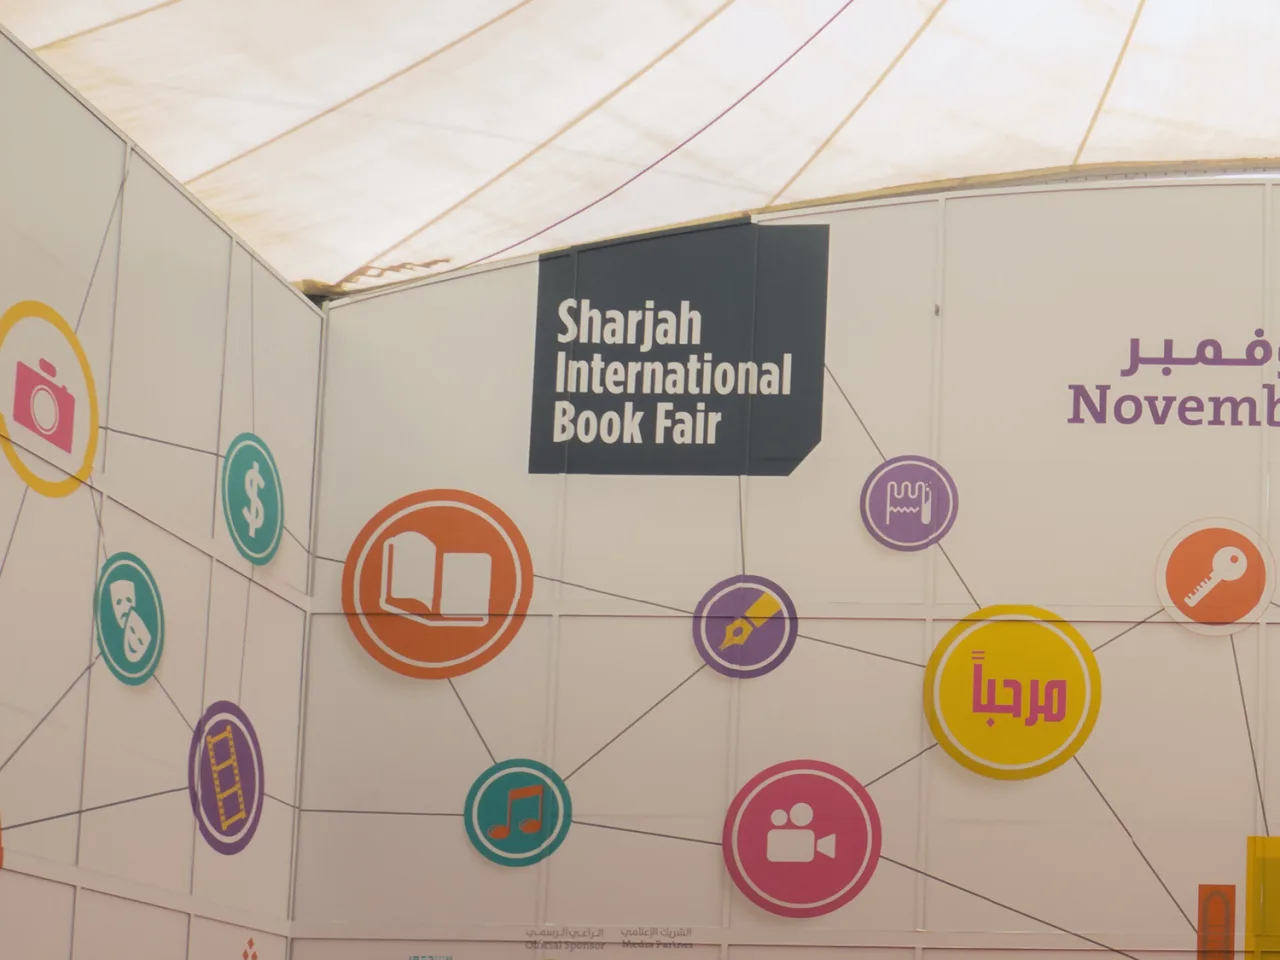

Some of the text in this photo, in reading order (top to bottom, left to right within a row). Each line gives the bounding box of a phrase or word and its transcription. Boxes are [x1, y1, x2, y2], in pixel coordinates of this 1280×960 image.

[557, 298, 701, 352] Sharjah
[555, 351, 792, 395] International
[553, 401, 722, 444] Book Fair
[525, 928, 604, 939] الراعي الرسمي
[660, 927, 692, 939] الشريك
[564, 941, 606, 952] Sponsor
[621, 941, 694, 949] Media Partner
